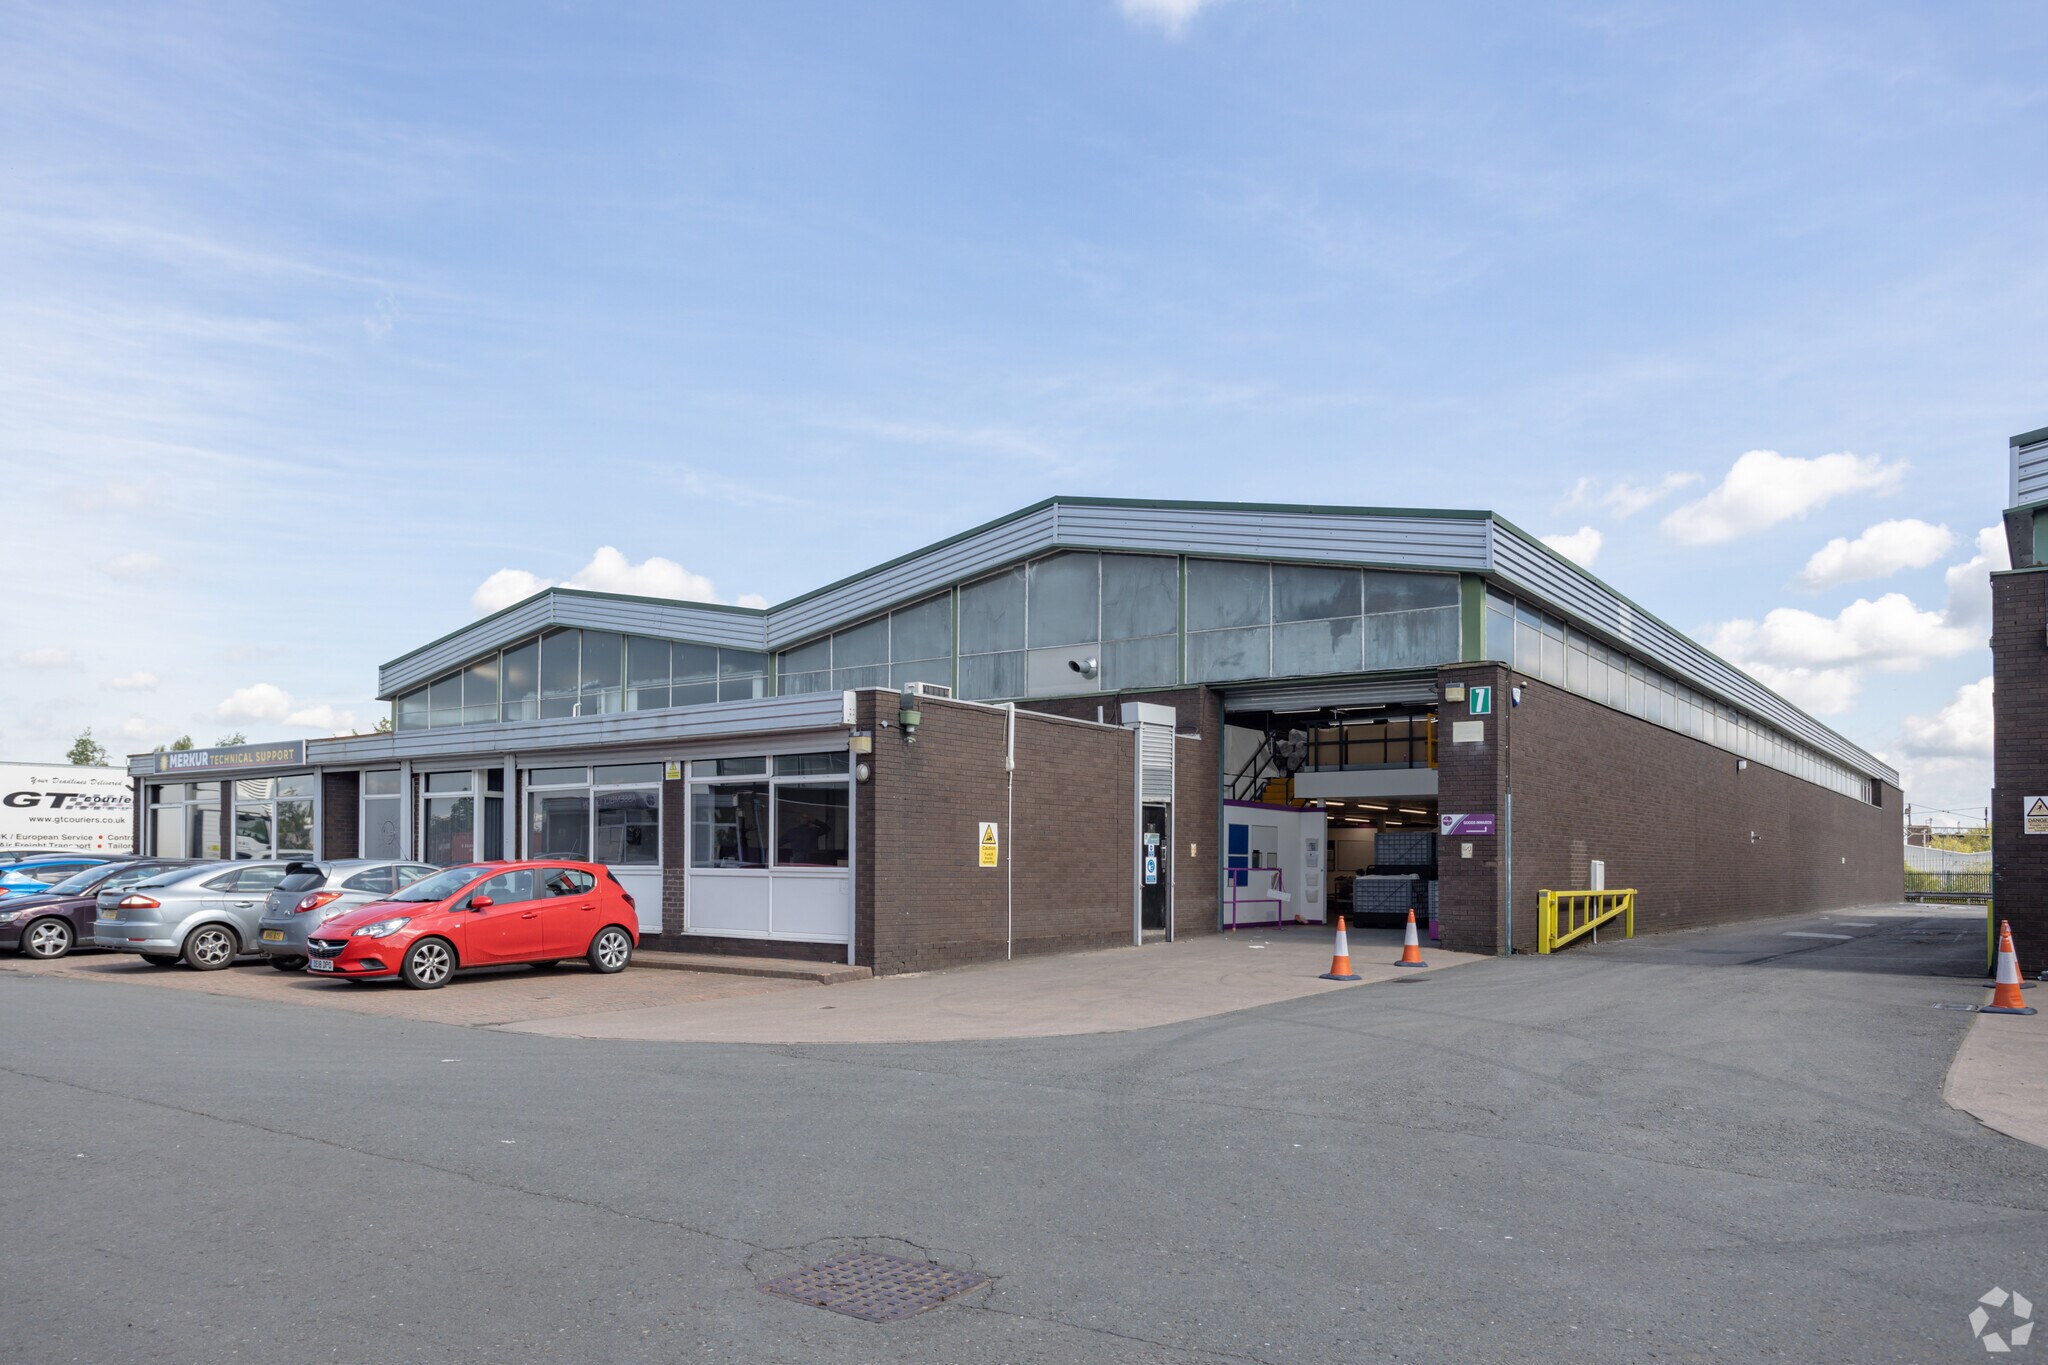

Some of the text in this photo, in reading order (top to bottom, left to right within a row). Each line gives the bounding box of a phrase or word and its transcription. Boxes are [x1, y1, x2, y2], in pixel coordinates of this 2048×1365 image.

[1475, 688, 1485, 713] 7
[169, 749, 295, 768] MERKUR TECHNICAL SUPPORT
[30, 776, 123, 786] Your Deadlines Delivered
[3, 791, 79, 808] GT
[28, 816, 126, 824] www.gtcouriers.co.uk
[16, 833, 59, 841] European
